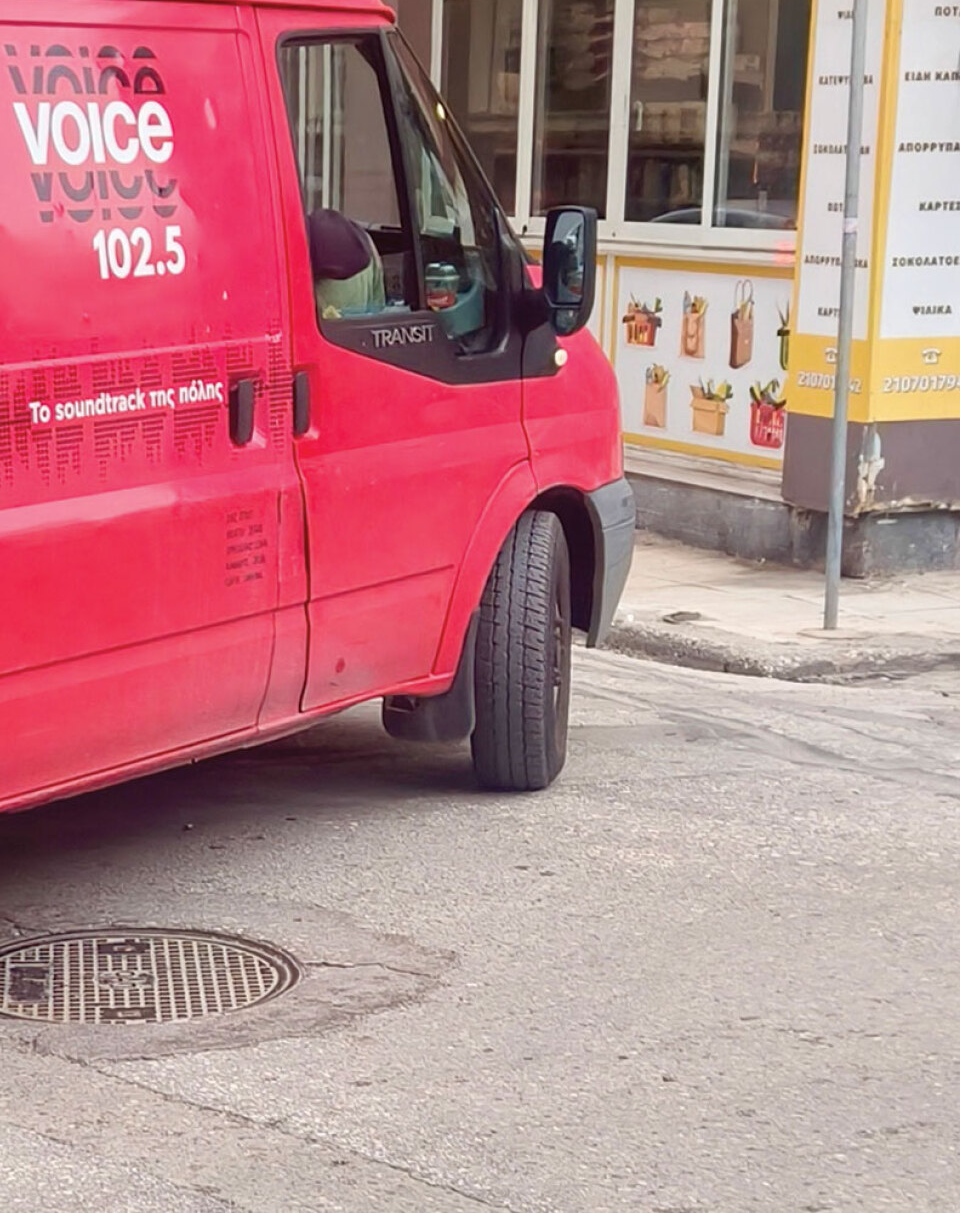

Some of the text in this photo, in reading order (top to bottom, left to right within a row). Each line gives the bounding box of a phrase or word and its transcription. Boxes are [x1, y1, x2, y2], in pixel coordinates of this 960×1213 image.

[935, 6, 960, 17] ΠΟΤ
[93, 225, 186, 280] 102.5
[913, 305, 952, 315] ΨΙΛΙΚΑ
[371, 324, 435, 348] TRANSIT
[29, 379, 224, 424] Το soundtrack της πόλης
